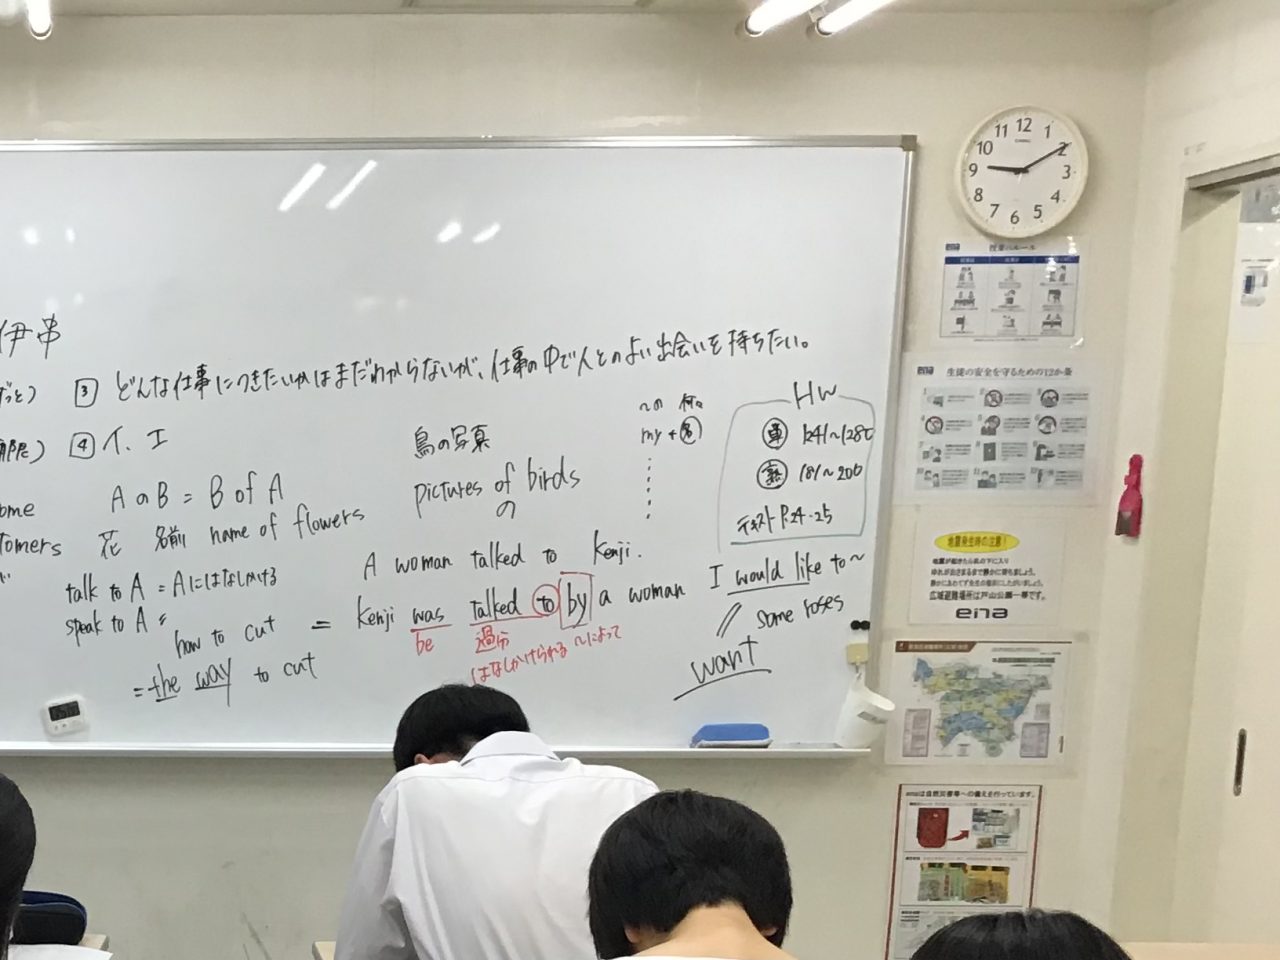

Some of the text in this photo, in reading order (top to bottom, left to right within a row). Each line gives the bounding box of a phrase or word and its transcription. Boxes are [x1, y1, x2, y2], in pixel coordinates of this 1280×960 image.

[995, 124, 1008, 138] 11
[1016, 118, 1032, 133] 12
[1044, 125, 1051, 138] 1
[977, 140, 993, 155] 10
[969, 163, 978, 177] 9
[1062, 165, 1071, 179] 3
[974, 188, 983, 202] 8
[1051, 190, 1061, 204] 4
[990, 204, 999, 218] 7
[1010, 211, 1020, 224] 6
[1033, 204, 1042, 219] 5
[414, 424, 491, 459] 鳥の写真
[641, 427, 663, 446] my
[210, 474, 224, 509] B
[235, 471, 257, 505] of
[269, 473, 284, 505] A
[414, 456, 581, 519] pictures of birds
[98, 529, 123, 559] 花
[210, 526, 250, 546] name
[259, 512, 278, 540] of
[293, 503, 365, 539] flowers
[363, 552, 376, 580] A
[395, 554, 453, 575] woman
[470, 541, 526, 571] talked
[543, 548, 557, 564] to
[709, 564, 724, 589] I
[736, 557, 784, 586] would
[795, 551, 821, 581] like
[66, 572, 99, 603] talk
[109, 583, 122, 602] to
[130, 572, 145, 603] A
[413, 608, 445, 626] was
[470, 587, 522, 621] talked
[536, 596, 555, 613] to
[568, 582, 587, 628] by
[599, 589, 612, 607] a
[628, 583, 686, 604] woman
[955, 607, 1009, 619] ena
[65, 609, 104, 647] speak
[112, 616, 125, 633] to
[136, 606, 148, 633] A
[757, 609, 794, 629] some
[174, 615, 275, 659] how to cut
[415, 632, 434, 655] be
[691, 635, 758, 684] want
[148, 663, 181, 701] the
[195, 657, 232, 708] way
[254, 666, 270, 683] to
[283, 652, 318, 680] cut
